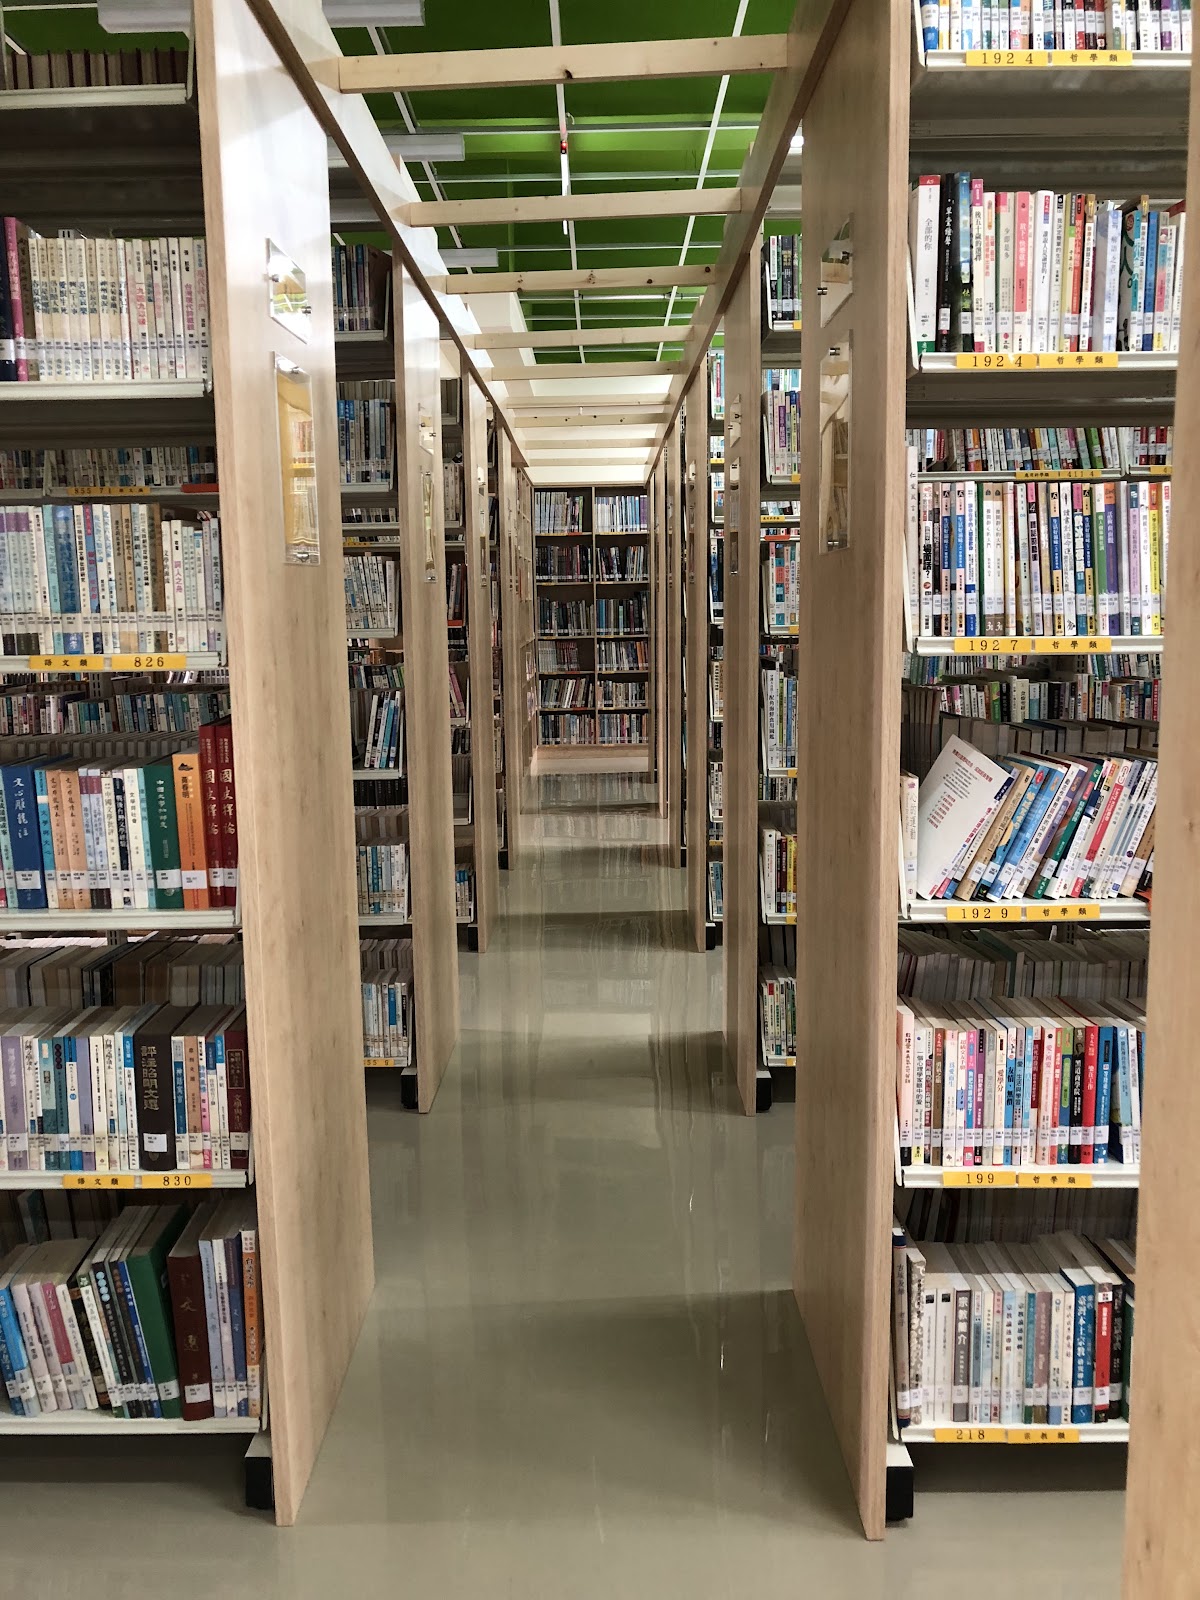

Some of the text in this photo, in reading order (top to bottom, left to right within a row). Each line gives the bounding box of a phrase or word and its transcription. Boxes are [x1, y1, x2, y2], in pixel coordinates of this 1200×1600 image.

[1070, 53, 1117, 62] 哲學類
[1057, 355, 1103, 364] 哲學類
[1052, 640, 1097, 649] 哲學類
[45, 658, 87, 666] 語文類
[134, 657, 164, 667] 826
[1043, 908, 1086, 916] 哲學類
[77, 1177, 118, 1185] 語文類
[163, 1176, 191, 1186] 830
[966, 1173, 994, 1184] 199
[1032, 1175, 1076, 1184] 哲學類
[956, 1430, 985, 1440] 218
